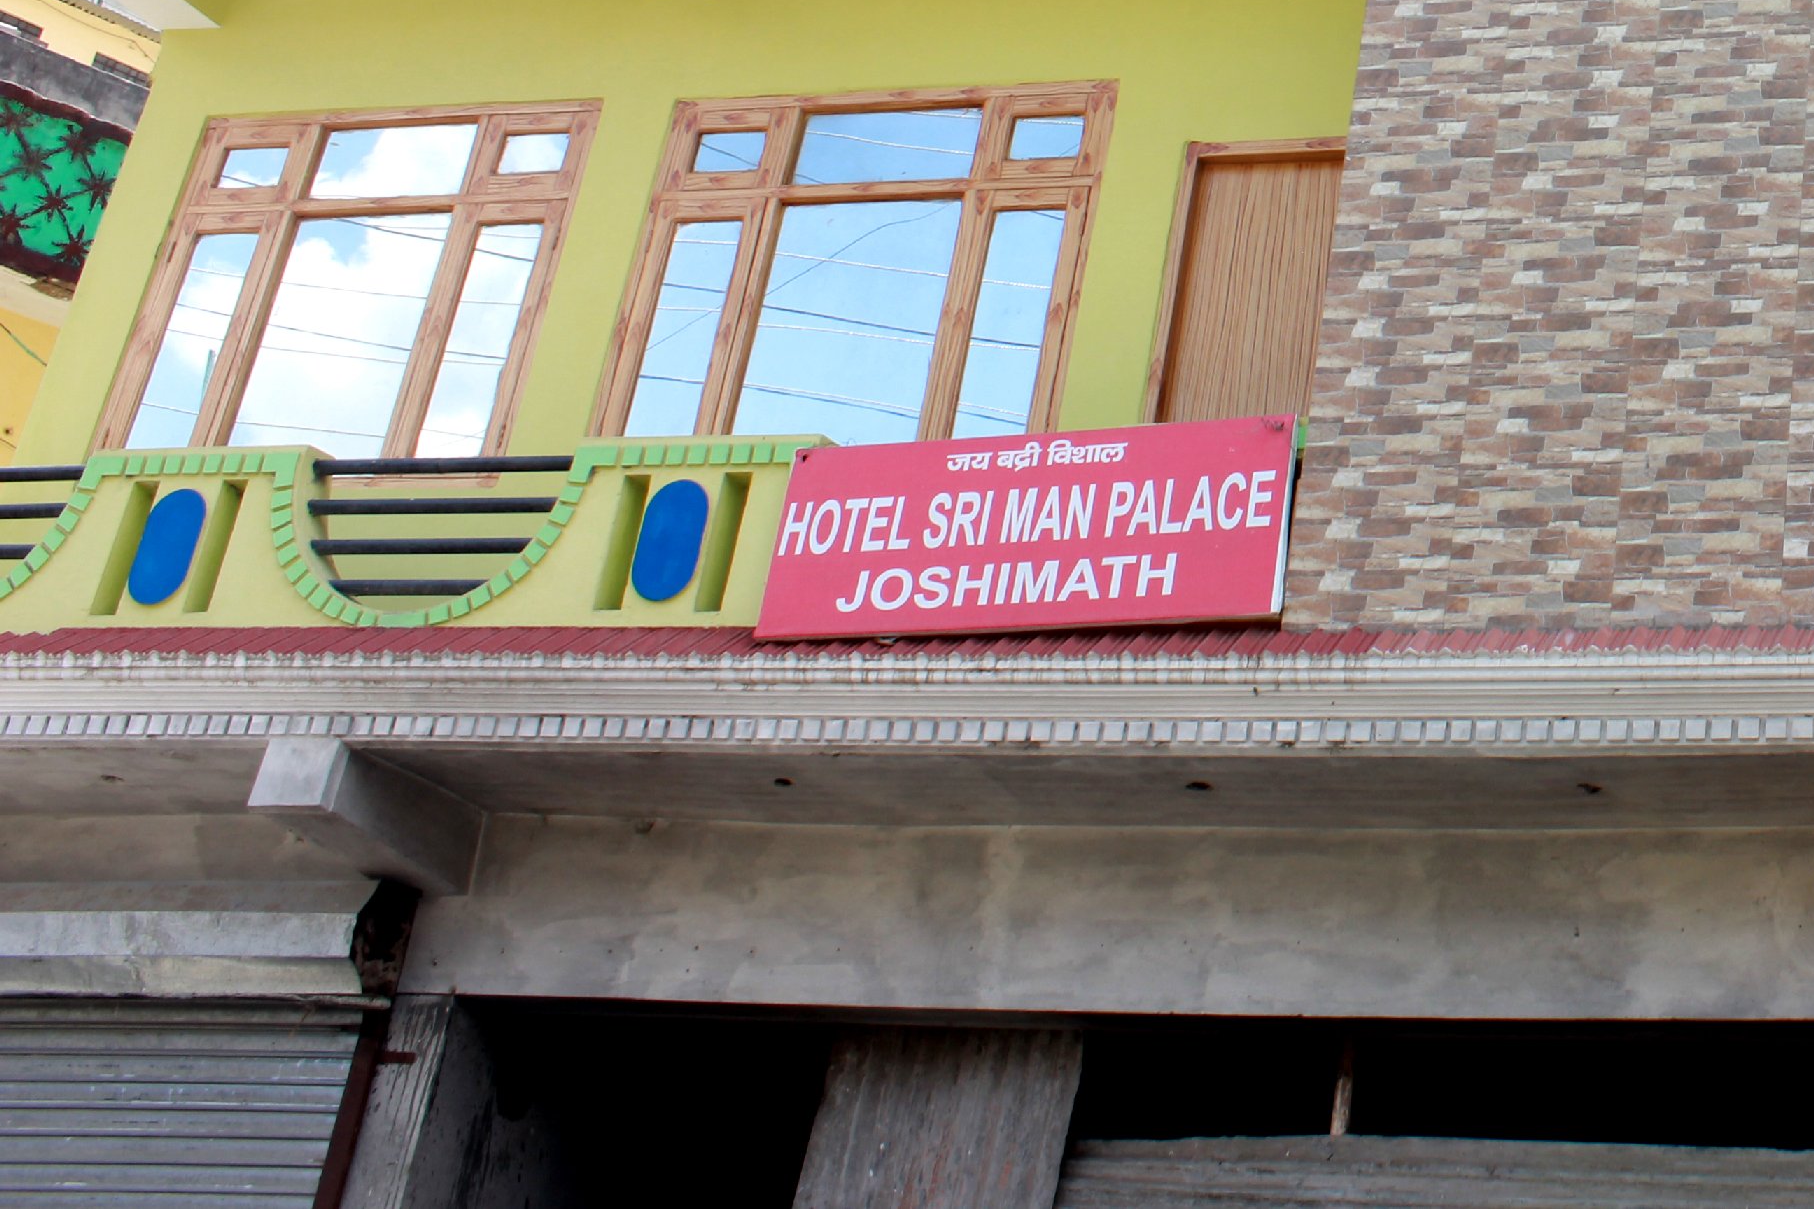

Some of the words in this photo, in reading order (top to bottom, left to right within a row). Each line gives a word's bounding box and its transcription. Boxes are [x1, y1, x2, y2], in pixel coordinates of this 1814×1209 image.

[946, 452, 993, 472] जय
[997, 441, 1043, 472] बद्री
[1046, 439, 1129, 466] विशाल
[777, 495, 911, 557] HOTEL
[922, 490, 995, 549] SRI
[999, 483, 1097, 544] MAN
[1103, 469, 1277, 539] PALACE
[835, 552, 1178, 613] JOSHIMATH
